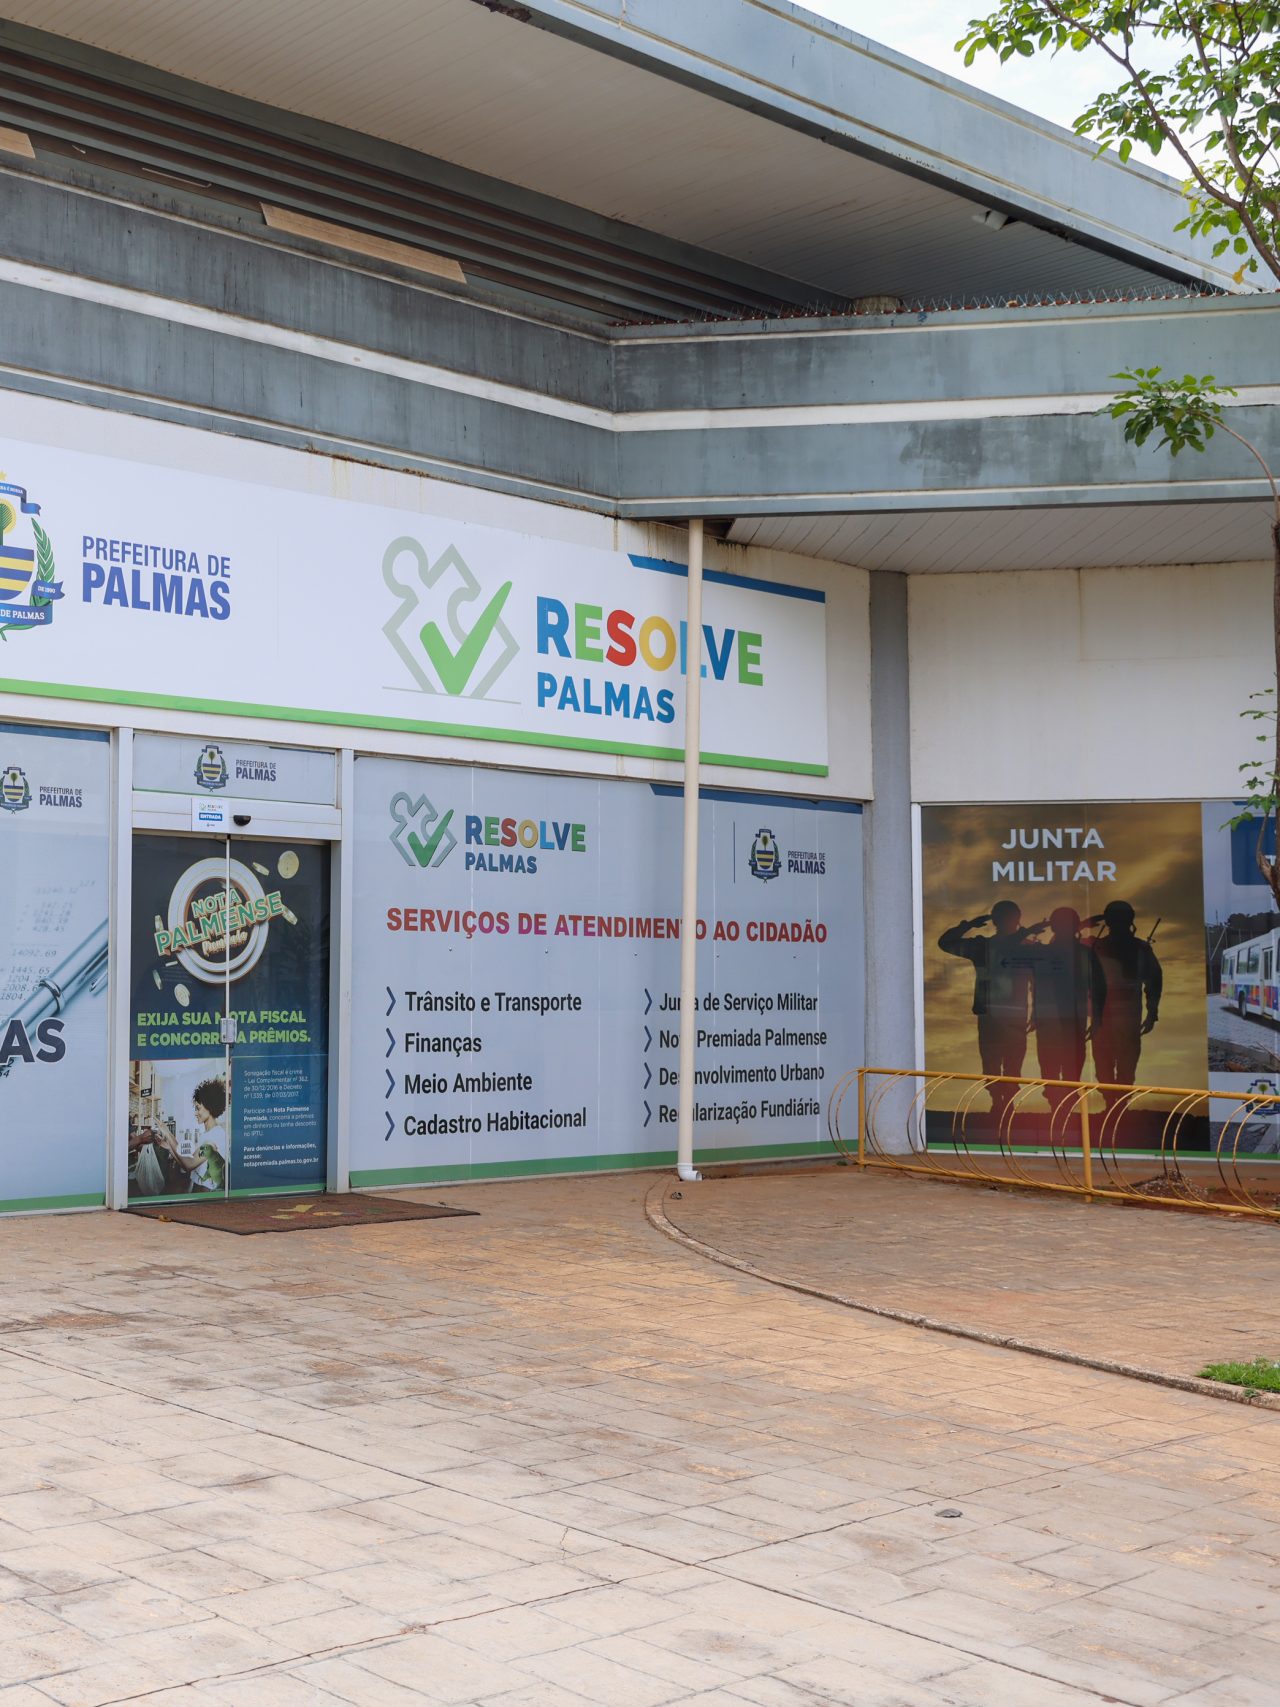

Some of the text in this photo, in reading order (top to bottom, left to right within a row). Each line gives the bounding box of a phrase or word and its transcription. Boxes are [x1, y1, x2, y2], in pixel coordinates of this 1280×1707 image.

[83, 535, 231, 579] PREFEITURA DE
[82, 561, 231, 621] PALMAS
[0, 608, 11, 618] DE
[12, 609, 45, 620] PALMAS
[536, 671, 675, 724] PALMAS
[235, 767, 276, 782] PALMAS
[236, 759, 268, 769] PREFEITURA
[39, 794, 82, 808] PALMAS
[40, 786, 82, 796] PREFEITURA DE
[465, 815, 586, 853] RESOLVE
[1001, 828, 1104, 850] JUNTA
[465, 852, 537, 875] PALMAS
[788, 850, 826, 861] PREFEITURA DE
[788, 859, 826, 875] PALMAS
[992, 861, 1117, 882] MILITAR
[191, 888, 242, 918] NOTA
[154, 890, 287, 957] PALMENSE
[386, 908, 827, 944] SERVIÇOS DE ATENDIMENO AO CIDADÃO
[404, 991, 582, 1016] Trânsito e Transporte
[659, 992, 818, 1016] Jua de Serviço Militar
[137, 1012, 179, 1027] EXIJA
[182, 1012, 212, 1025] SUA
[260, 1010, 306, 1023] FISCAL
[137, 1027, 311, 1047] E CONCORR A PRÊMIOS.
[404, 1032, 482, 1057] Finanças
[697, 1028, 761, 1047] Premiada
[765, 1027, 827, 1047] Palmense
[404, 1072, 533, 1095] Meio Ambiente
[659, 1064, 824, 1086] Denvolvimento Urbano
[403, 1107, 587, 1136] Cadastro Habitacional
[659, 1098, 821, 1124] Relarização Fundiária
